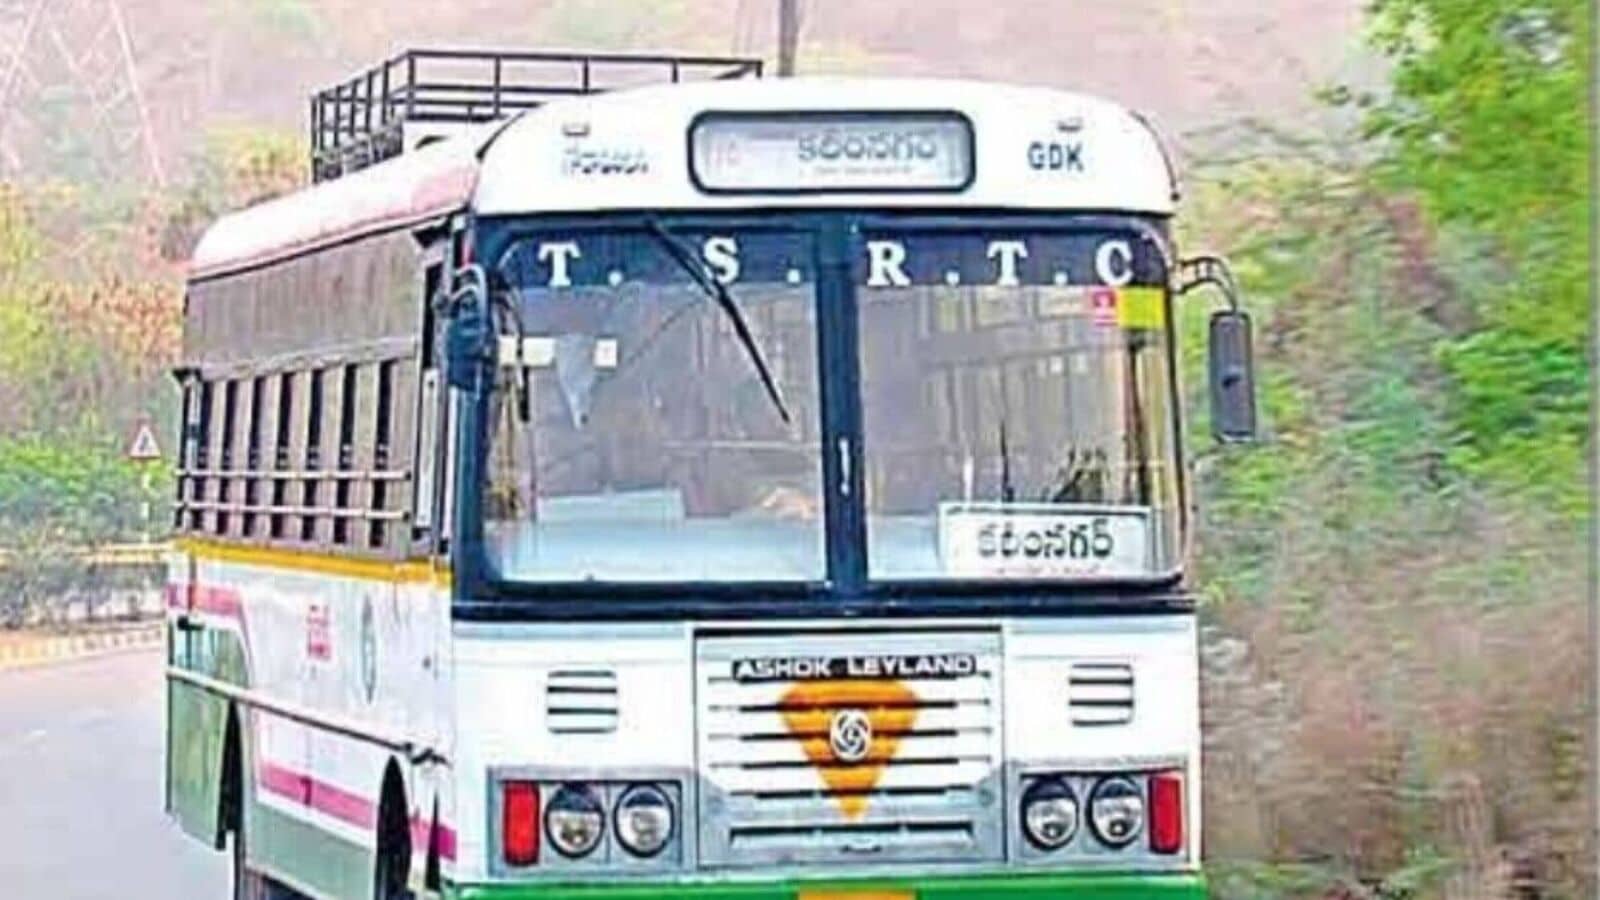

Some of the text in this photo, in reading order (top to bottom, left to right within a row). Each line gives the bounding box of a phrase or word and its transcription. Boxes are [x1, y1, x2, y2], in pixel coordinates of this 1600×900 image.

[1026, 141, 1085, 172] GDK
[736, 655, 974, 678] ASHOK LEYLAND
